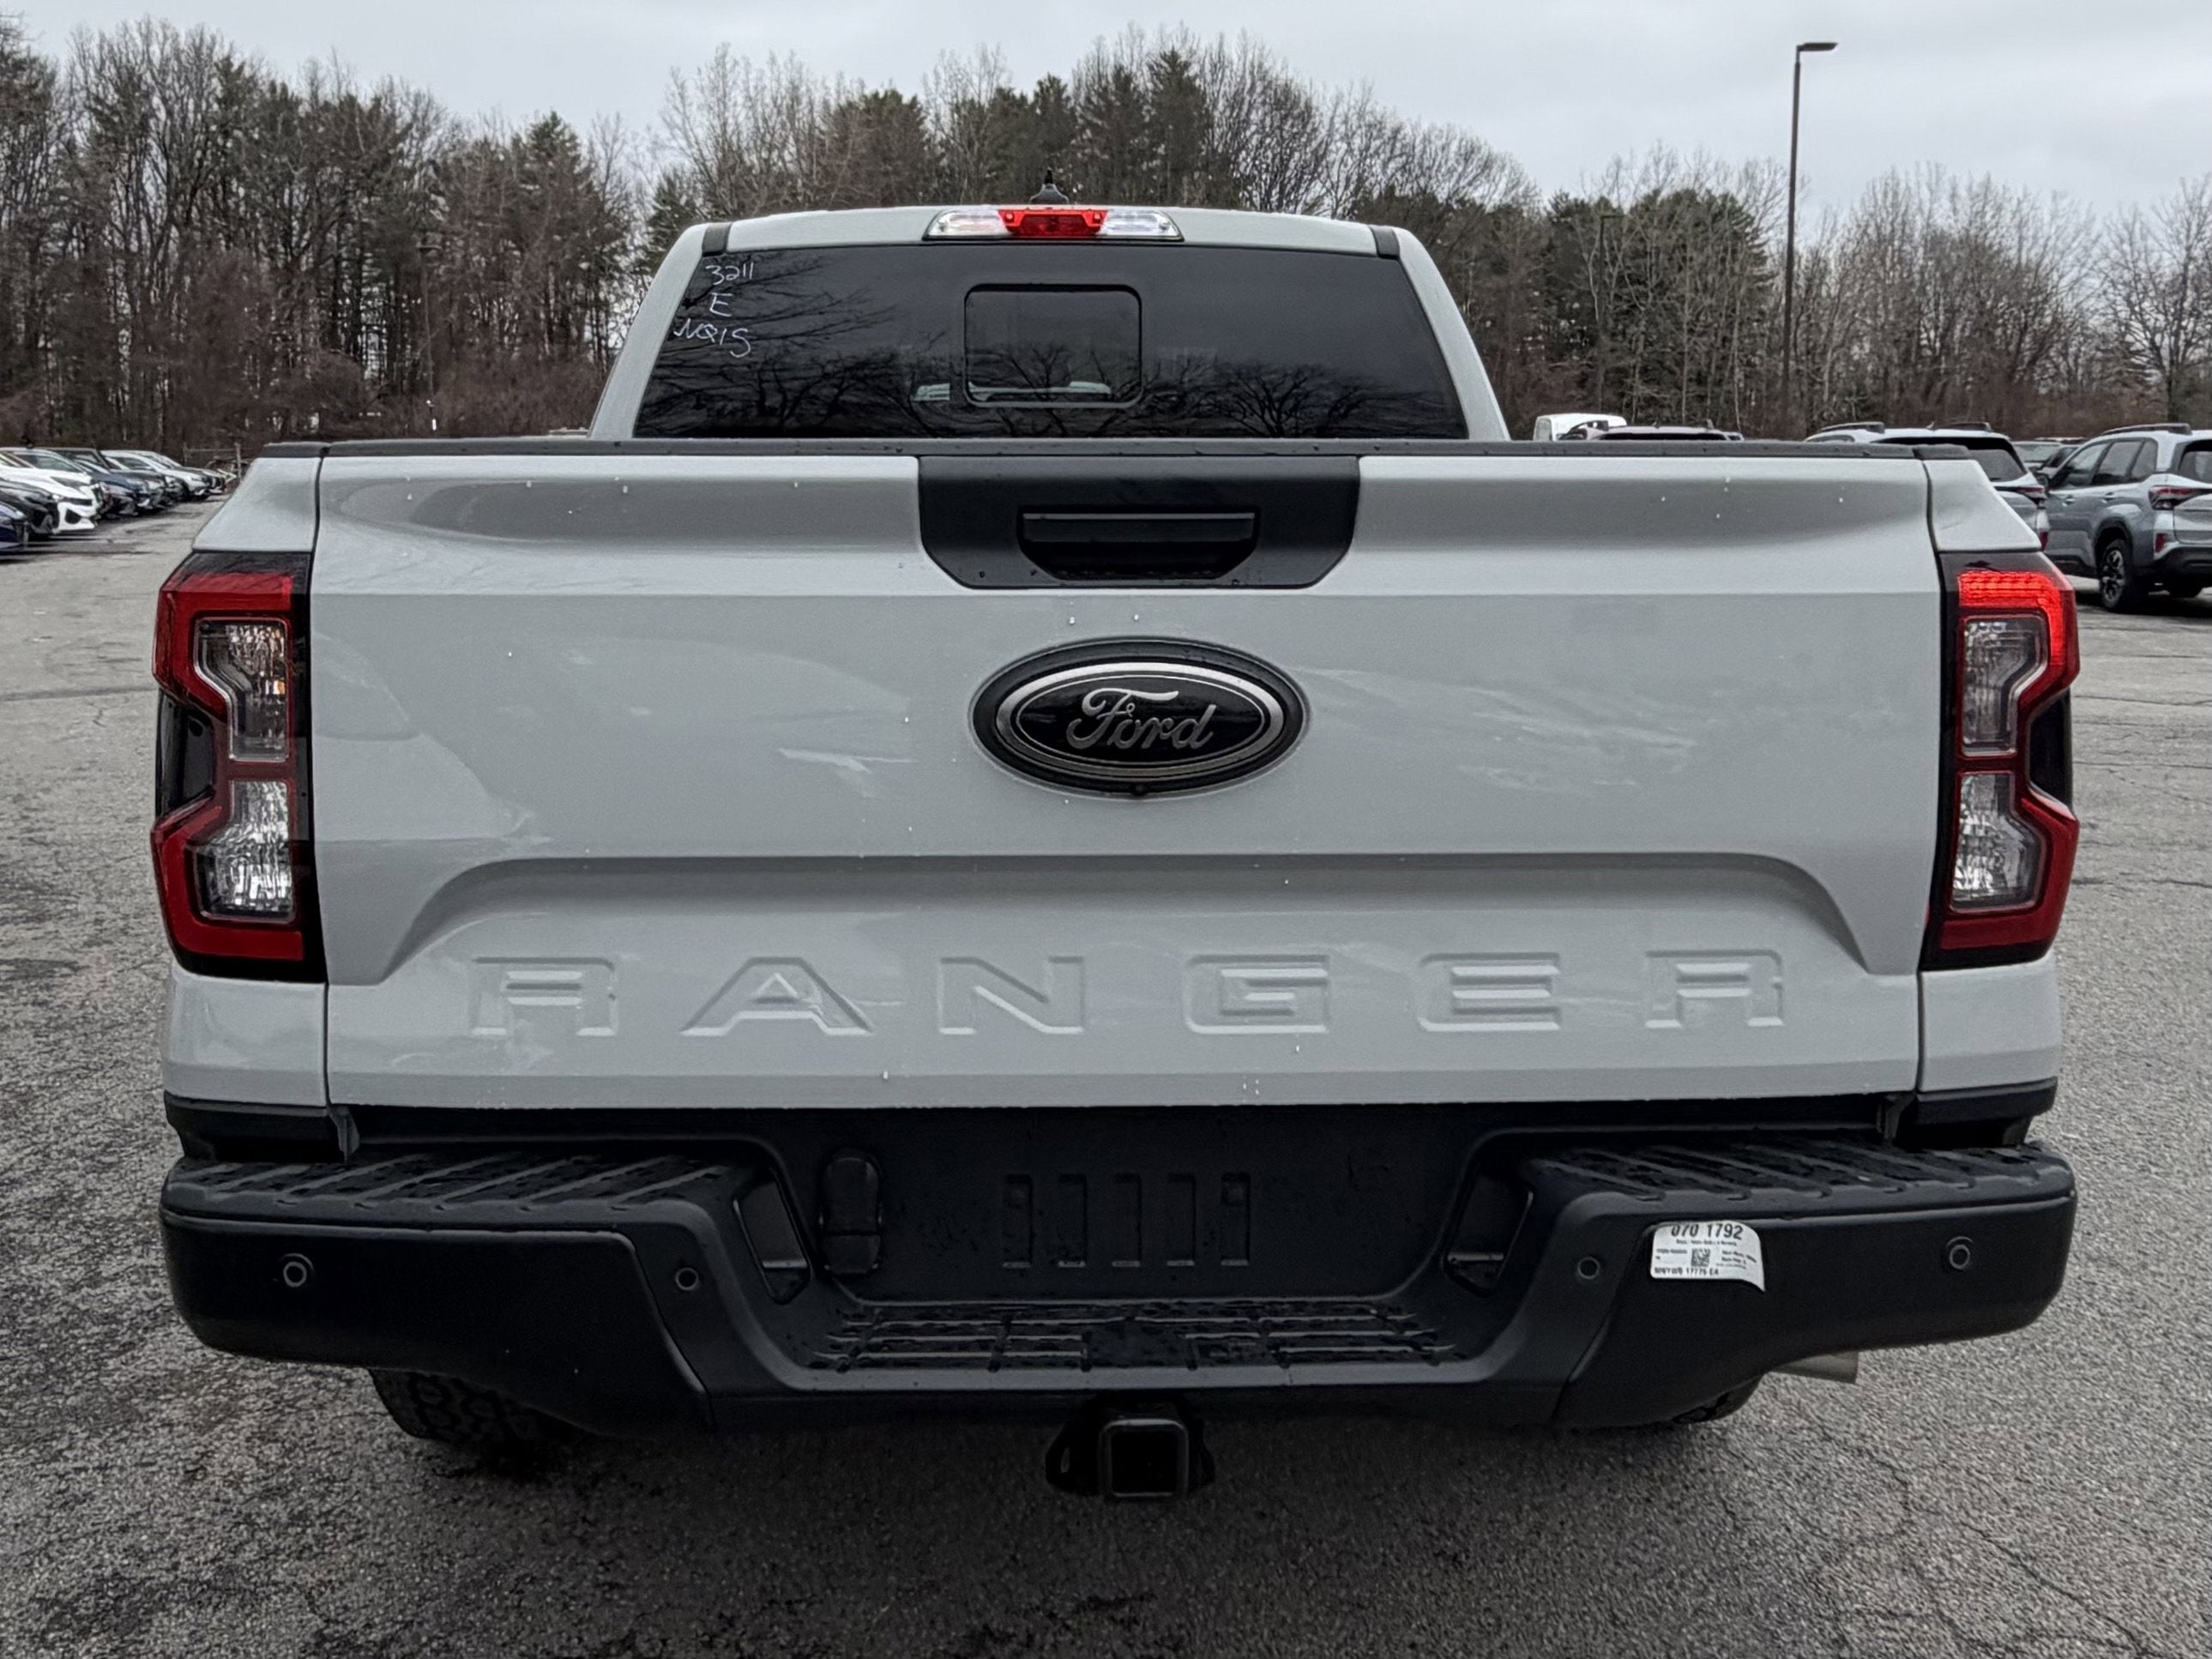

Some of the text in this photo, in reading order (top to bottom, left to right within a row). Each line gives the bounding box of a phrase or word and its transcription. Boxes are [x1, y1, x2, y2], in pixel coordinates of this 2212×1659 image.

[706, 262, 753, 285] 3211
[709, 293, 732, 317] E
[1066, 687, 1217, 750] Ford
[469, 950, 1784, 1035] RANGER
[1672, 1223, 1744, 1240] 070 1792
